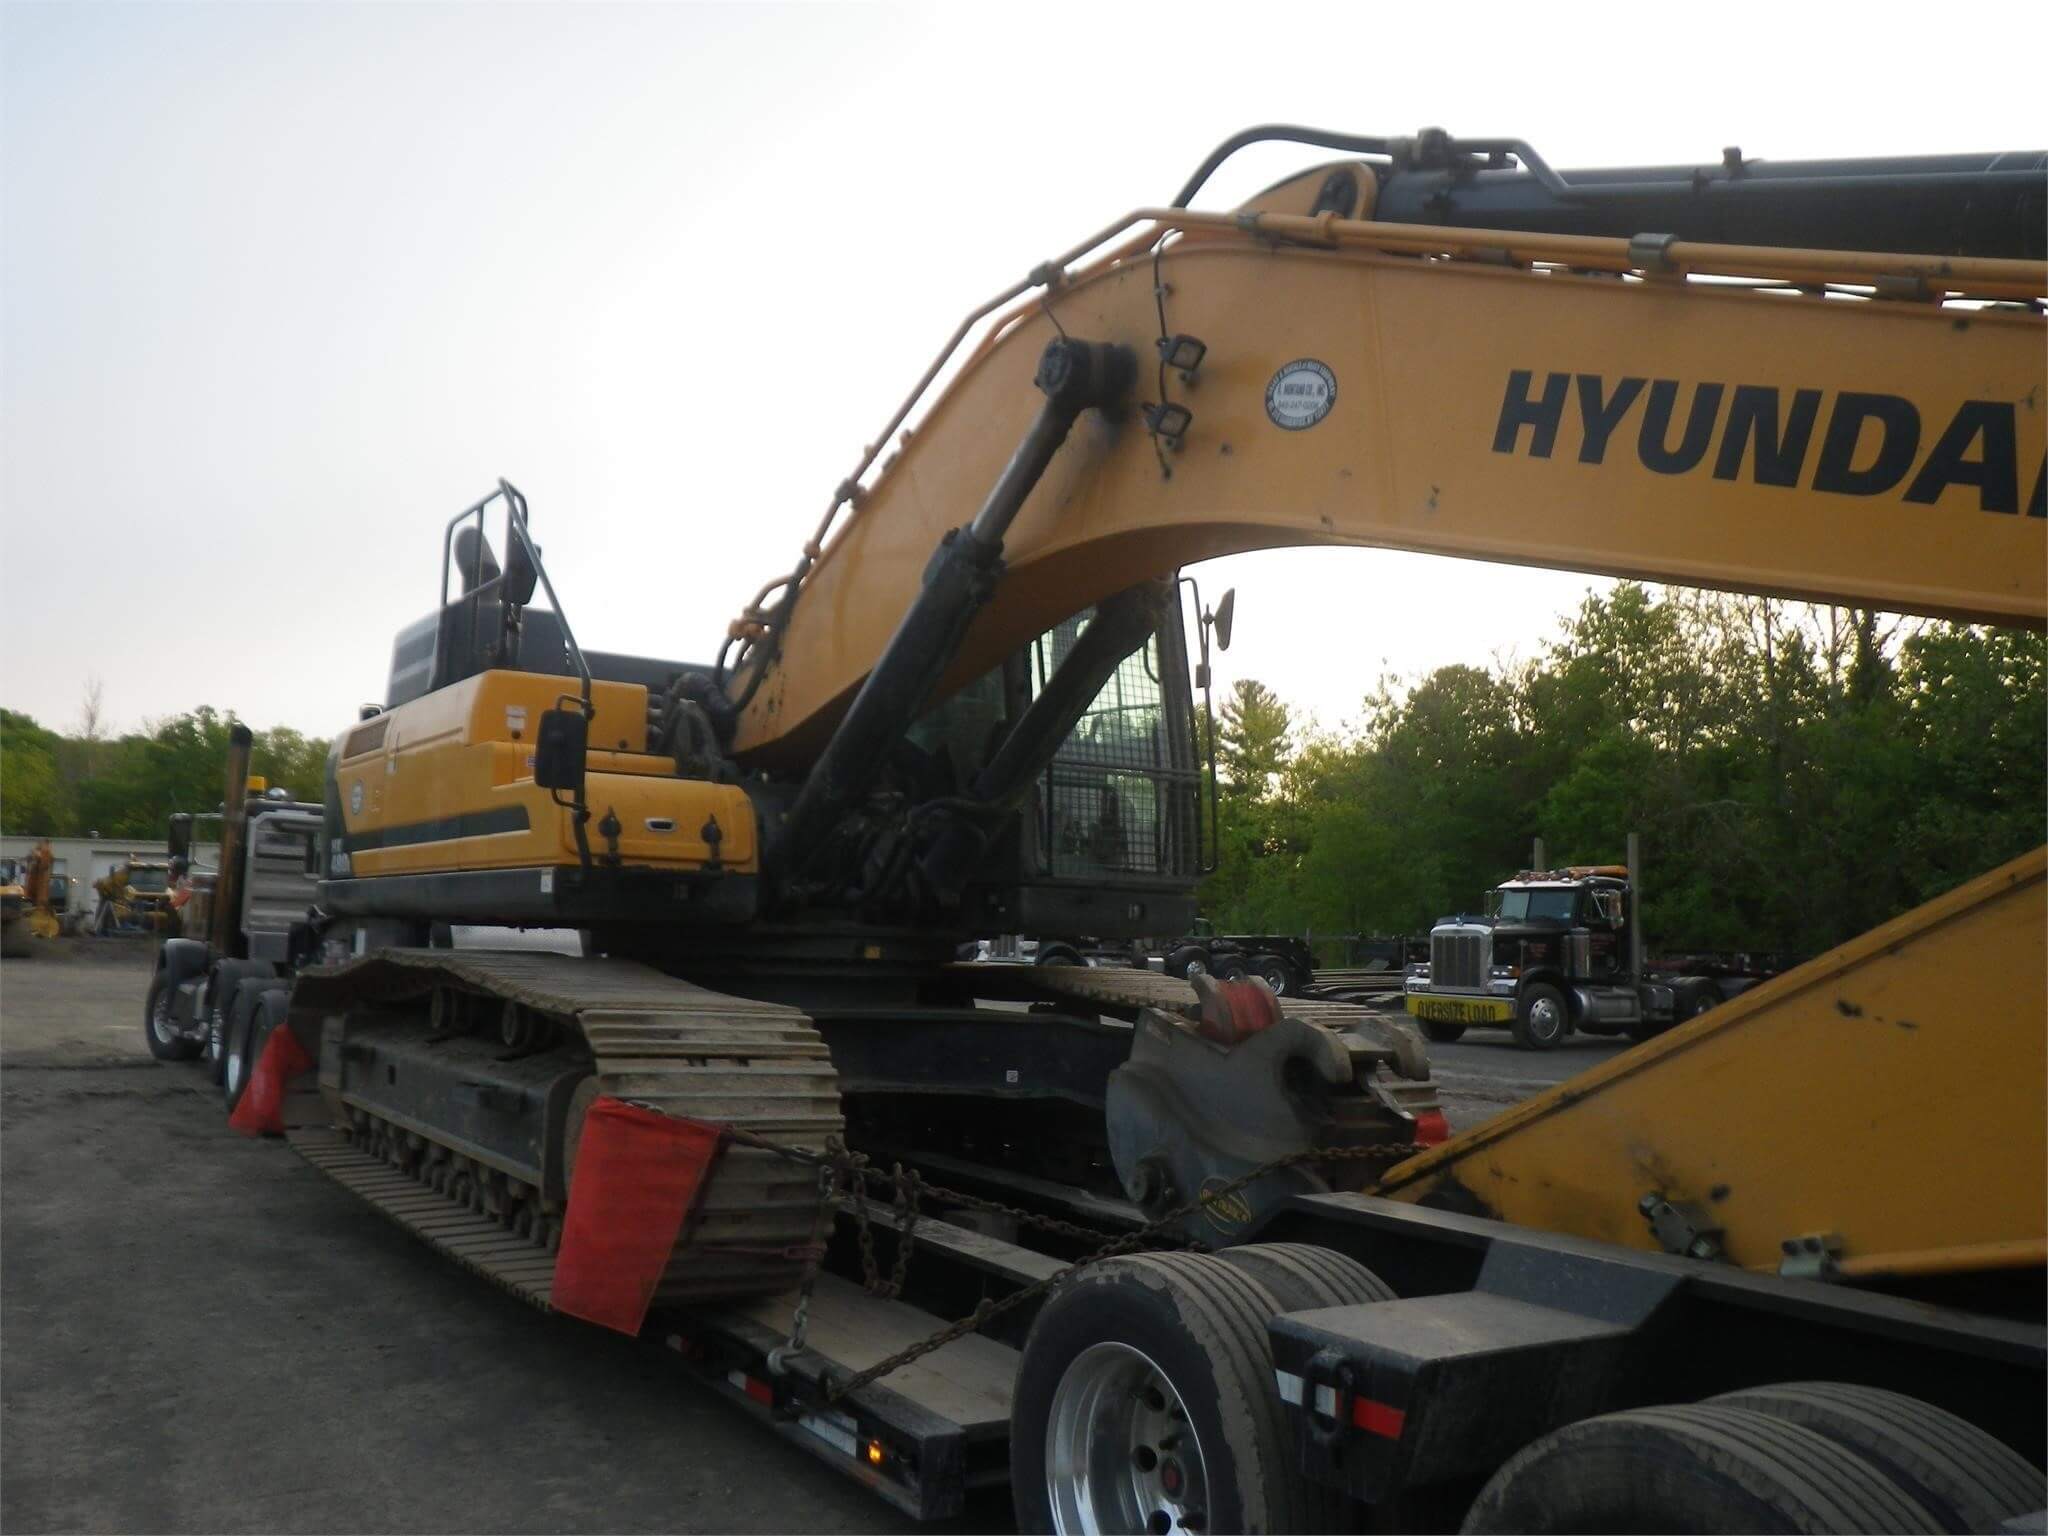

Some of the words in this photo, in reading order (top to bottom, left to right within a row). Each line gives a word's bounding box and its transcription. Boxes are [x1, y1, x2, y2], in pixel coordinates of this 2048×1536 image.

[1491, 369, 2048, 519] HYUNDA
[1417, 999, 1465, 1024] OVERSIZE
[1466, 1004, 1497, 1025] LOAD
